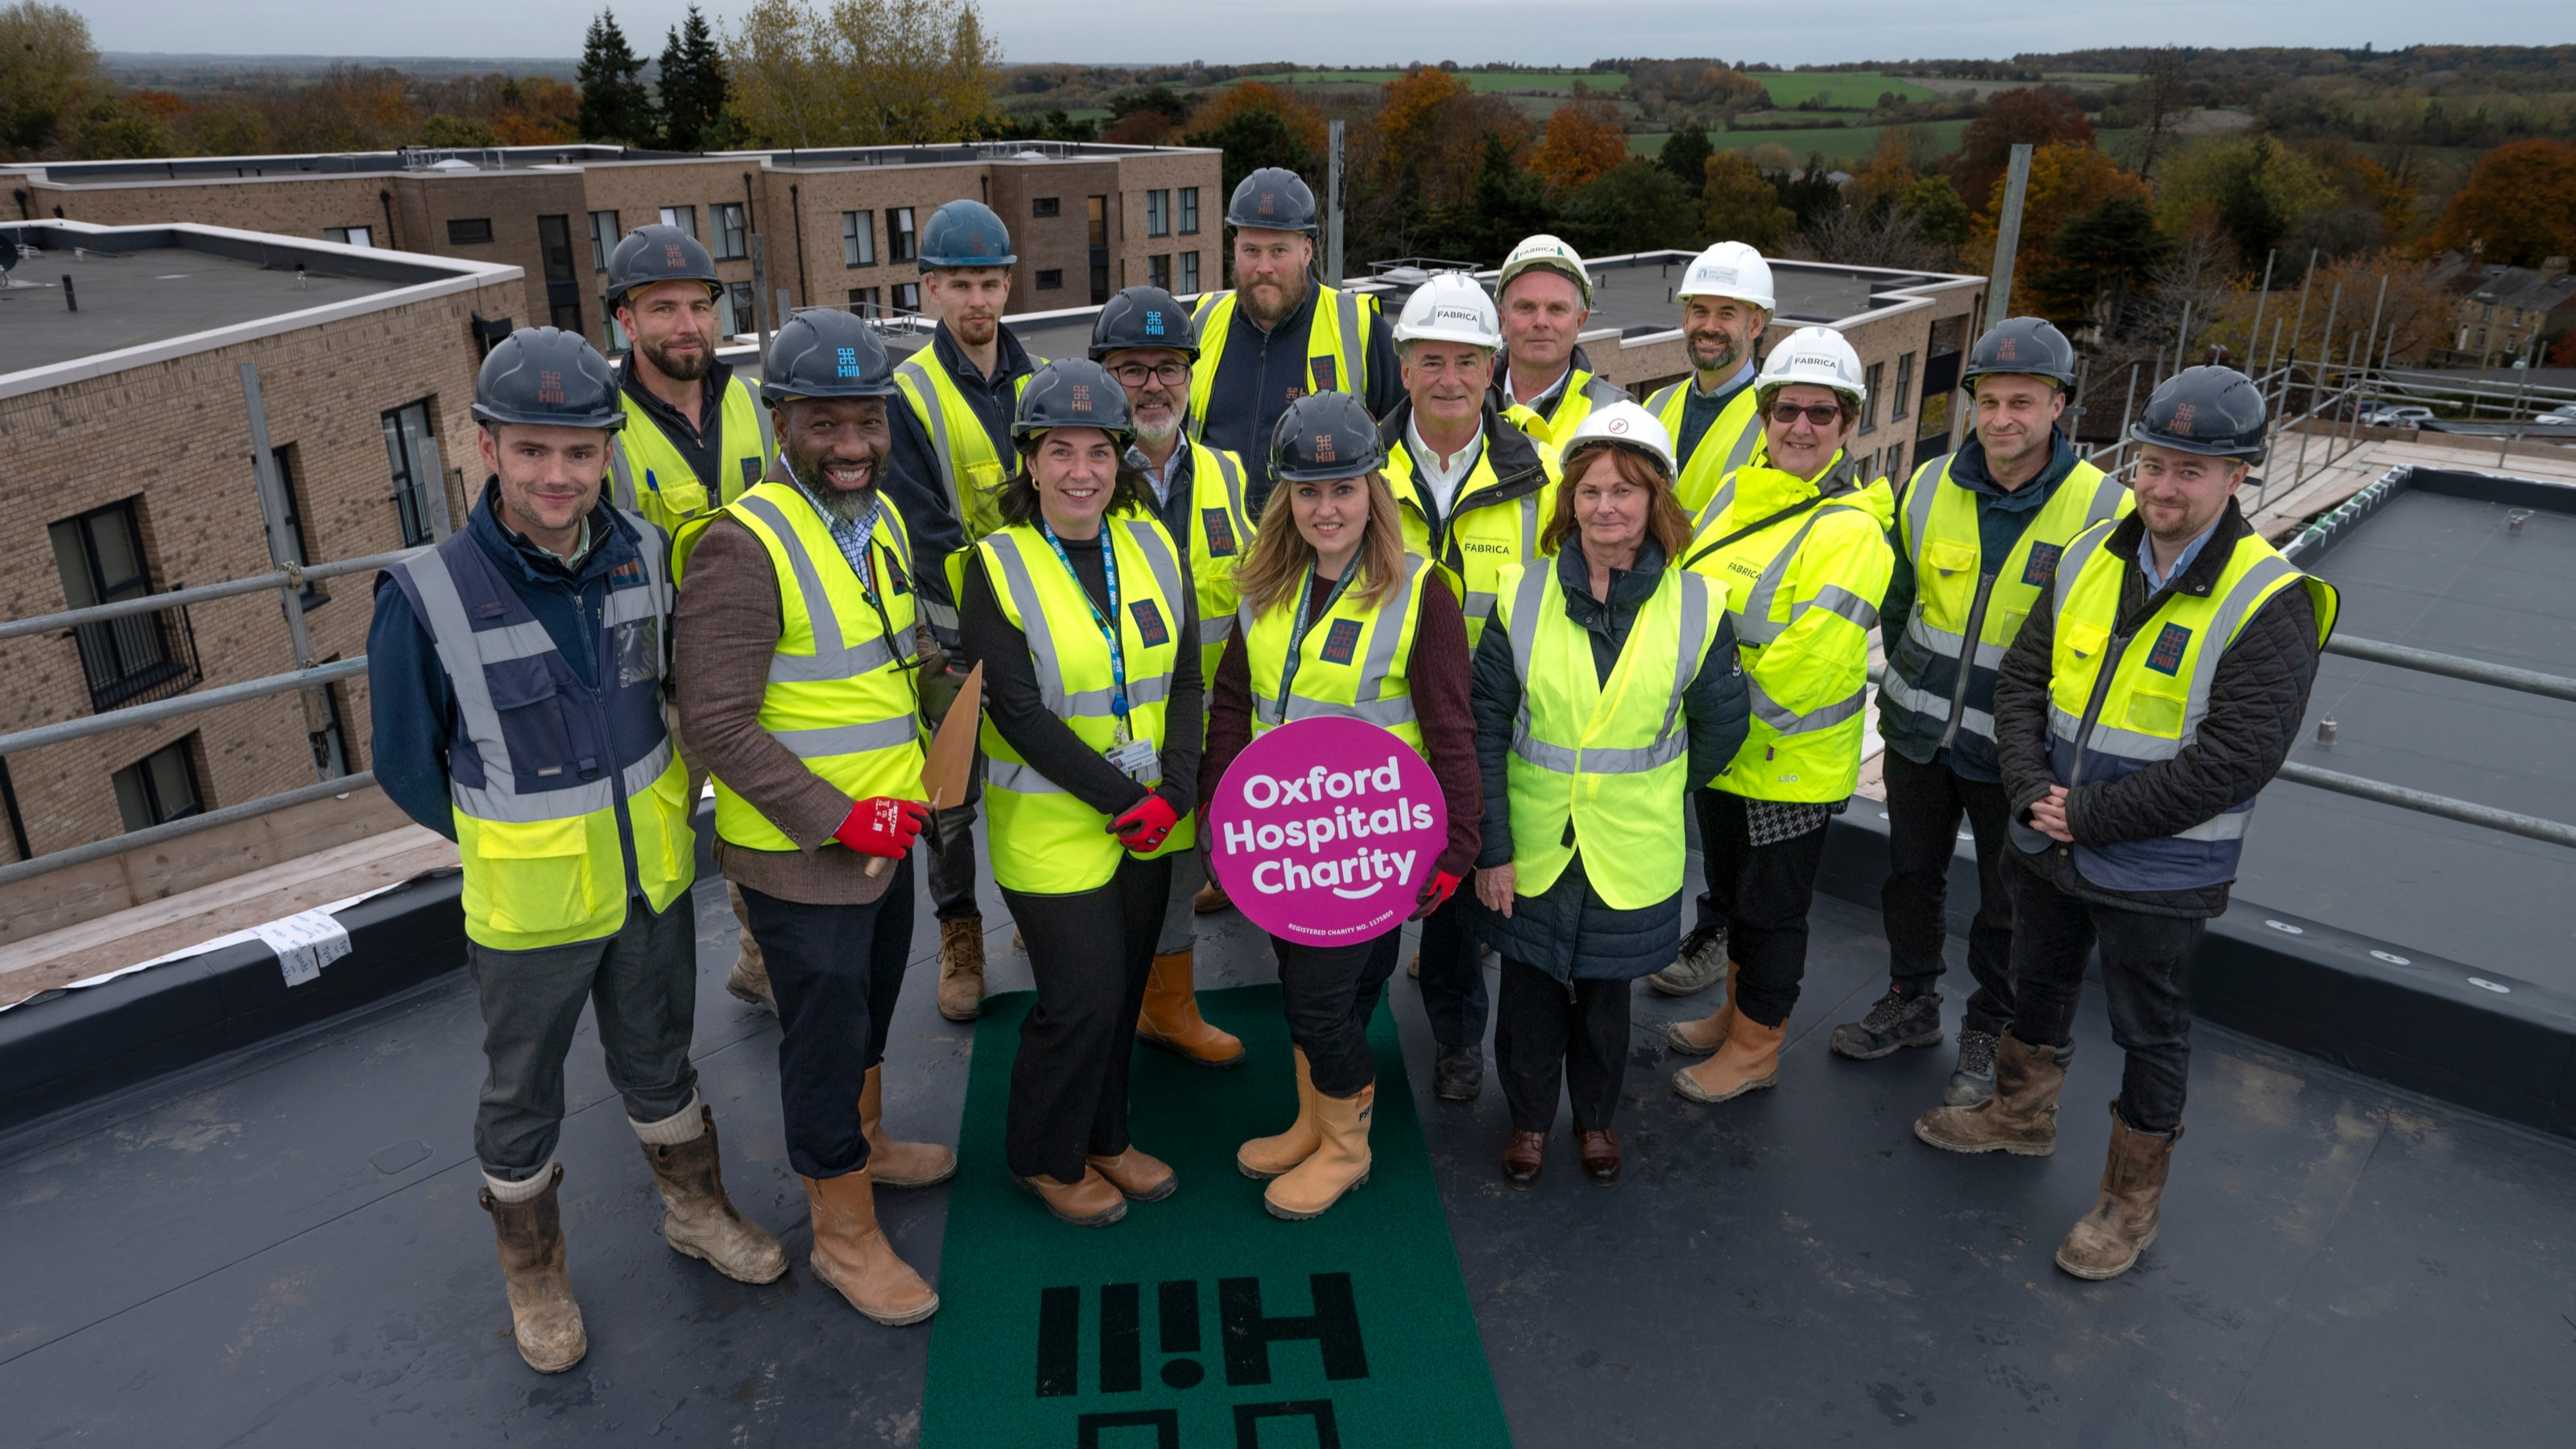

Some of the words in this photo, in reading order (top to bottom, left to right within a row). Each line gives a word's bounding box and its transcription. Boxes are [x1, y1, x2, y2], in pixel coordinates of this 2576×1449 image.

[1259, 205, 1273, 215] Hill
[1520, 246, 1556, 257] FABRICA
[667, 258, 686, 268] Hill
[1437, 311, 1478, 323] FABRICA
[1146, 324, 1164, 336] Hill
[1794, 357, 1836, 369] FABRICA
[1997, 351, 2016, 361] Hill
[837, 365, 860, 378] Hill
[539, 390, 564, 404] Hill
[1072, 400, 1092, 411] Hill
[2169, 419, 2191, 433] Hill
[1315, 451, 1335, 464] Hill
[1052, 541, 1064, 556] NHS
[1210, 535, 1232, 552] Hill
[1464, 543, 1510, 555] FABRICA
[1104, 551, 1113, 567] NHS
[1726, 562, 1762, 581] FABRICA
[2028, 568, 2049, 583] Hil
[1107, 571, 1115, 587] NHS
[1297, 602, 1309, 630] Hospitals
[1144, 626, 1165, 642] Hill
[1325, 646, 1350, 659] Hill
[2152, 651, 2177, 670] Hill
[1243, 755, 1401, 809] Oxford
[1778, 774, 1798, 782] LEO
[1223, 797, 1433, 855] Hospitals
[1252, 847, 1416, 894] Charity
[1288, 923, 1326, 936] REGISTERED
[1327, 926, 1354, 936] CHARITY
[1356, 923, 1369, 931] NO.
[1369, 909, 1394, 927] 1175809
[293, 952, 309, 973] Tyvek
[1036, 1272, 1370, 1398] Hill
